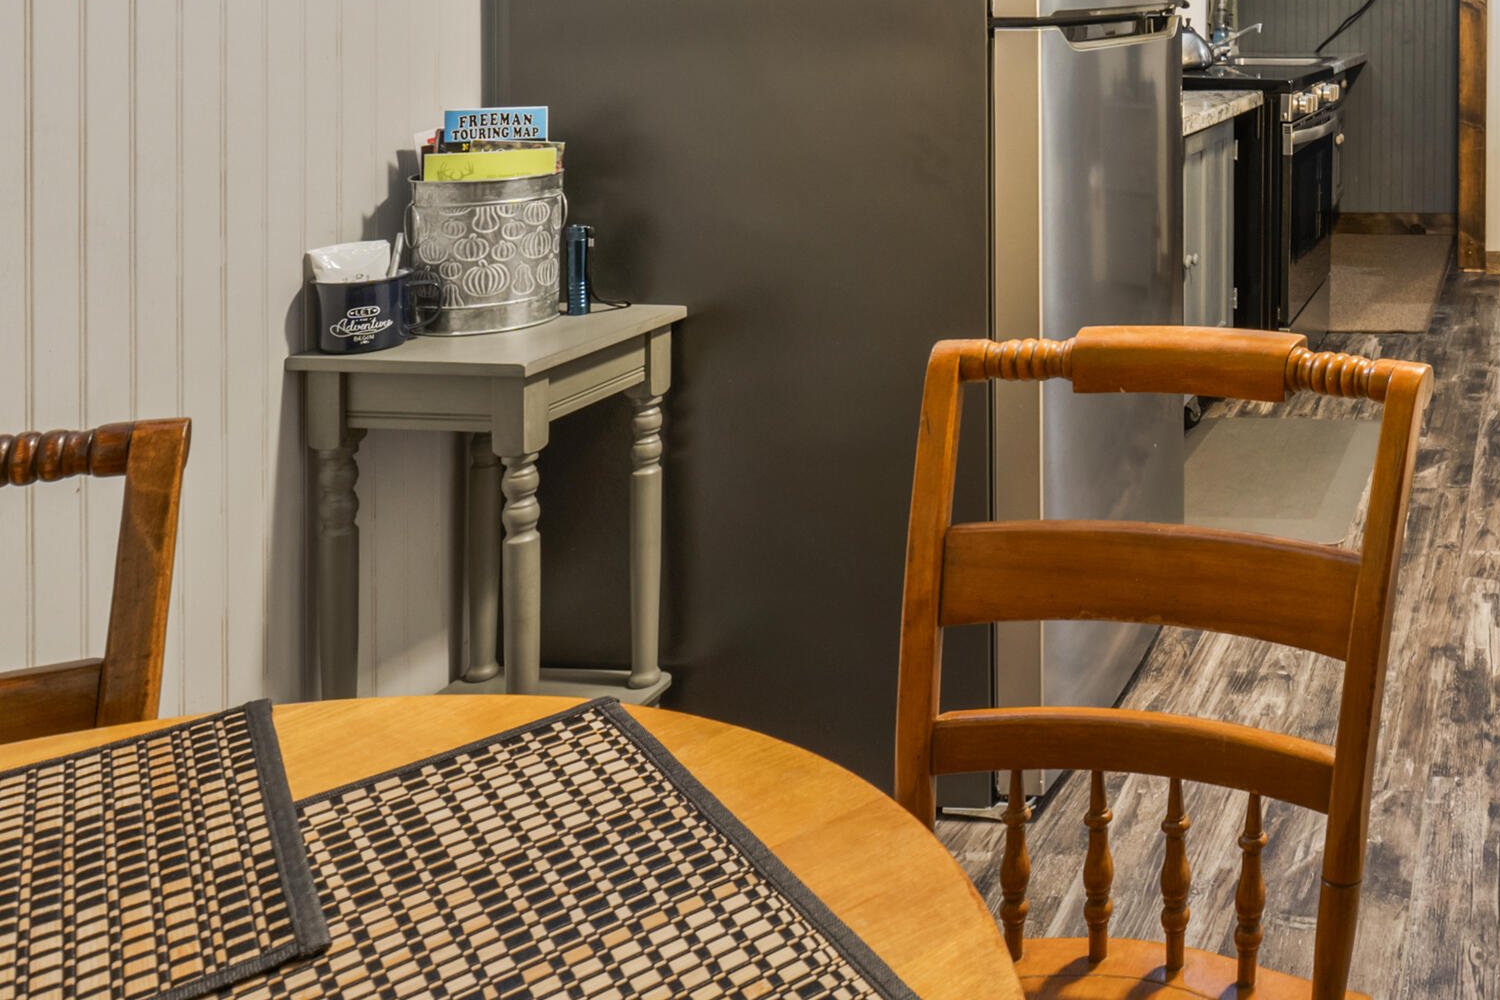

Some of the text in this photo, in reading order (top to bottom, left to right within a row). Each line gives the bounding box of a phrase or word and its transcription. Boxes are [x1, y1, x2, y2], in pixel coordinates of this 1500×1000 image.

[459, 113, 533, 129] FREEMAN
[452, 126, 540, 141] TOURING MAP
[355, 308, 371, 316] LET
